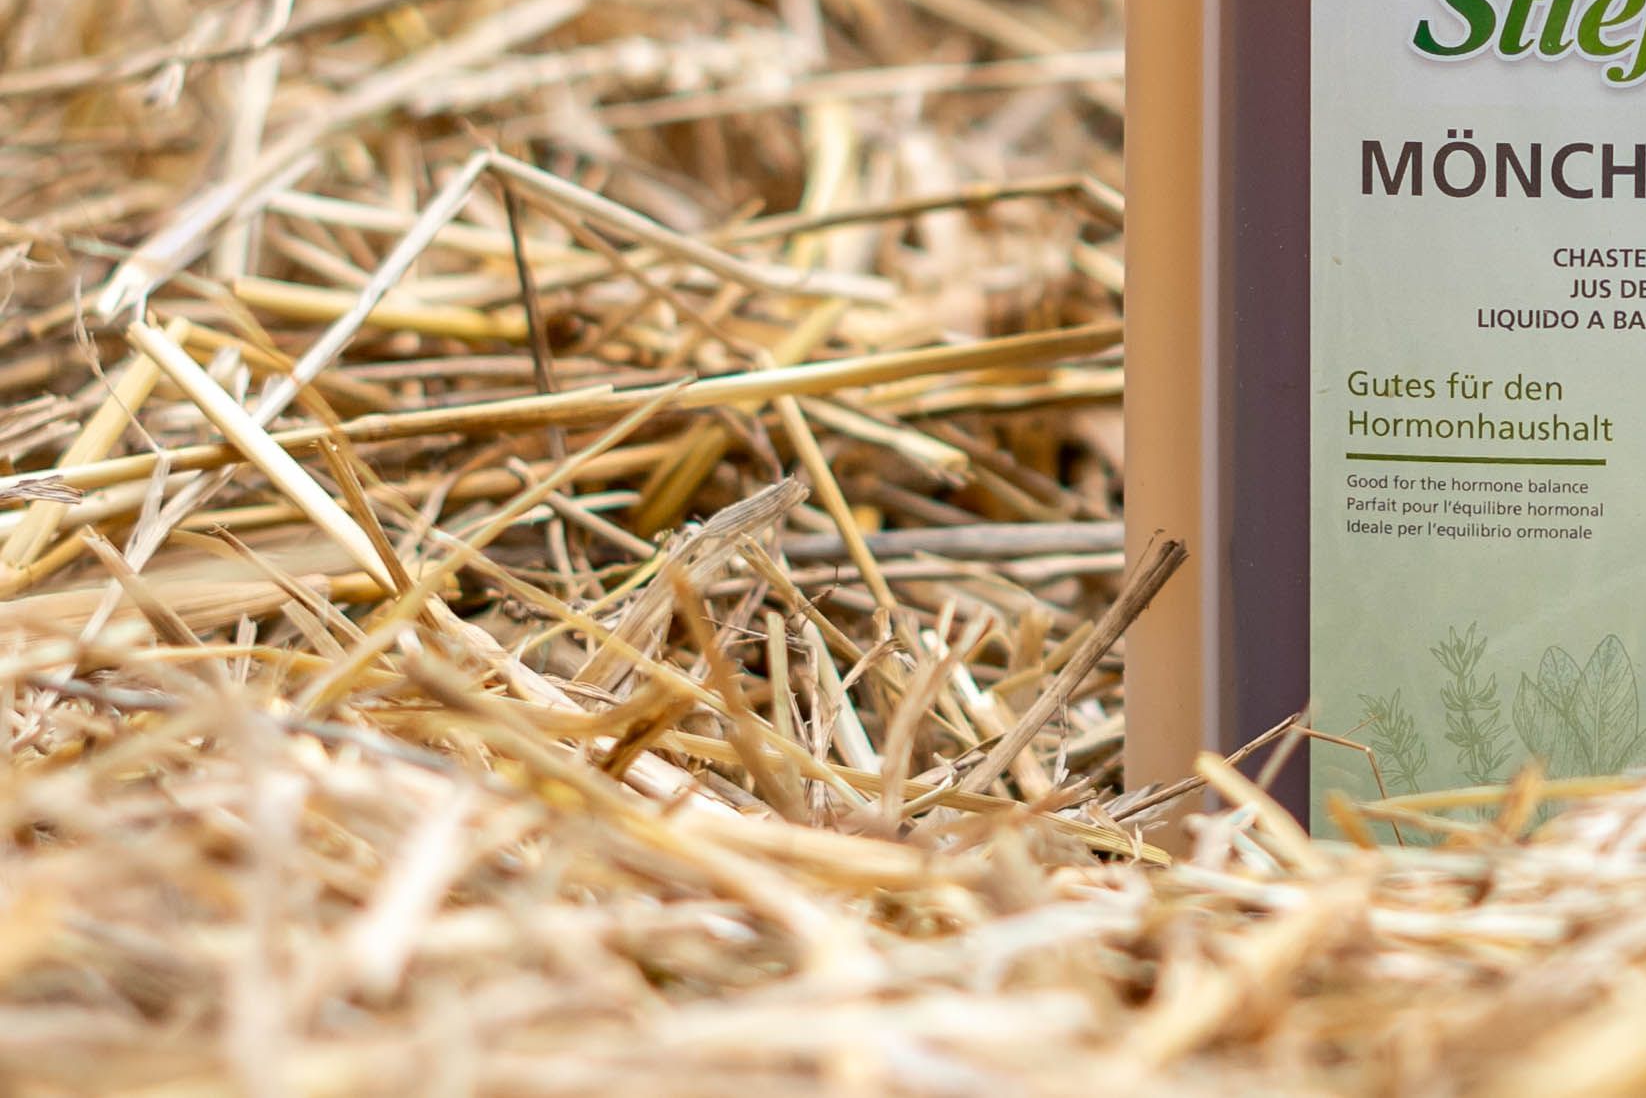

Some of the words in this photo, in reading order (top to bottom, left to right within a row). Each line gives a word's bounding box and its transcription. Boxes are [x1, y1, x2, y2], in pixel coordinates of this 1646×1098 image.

[1569, 279, 1612, 299] JUS
[1477, 308, 1580, 332] LIQUIDO
[1586, 310, 1606, 330] A
[1347, 370, 1436, 399] Gutes
[1445, 371, 1494, 400] für
[1504, 373, 1563, 401] den
[1348, 409, 1613, 442] Hormonhaushalt
[1346, 474, 1389, 489] Good
[1392, 474, 1417, 490] for
[1419, 476, 1447, 491] the
[1451, 477, 1524, 493] hormone
[1528, 478, 1589, 494] balance
[1346, 496, 1398, 513] Parfait
[1402, 501, 1440, 516] pour
[1527, 501, 1604, 518] hormonal
[1346, 519, 1393, 535] Ideale
[1397, 524, 1424, 538] per
[1516, 525, 1593, 540] ormonale
